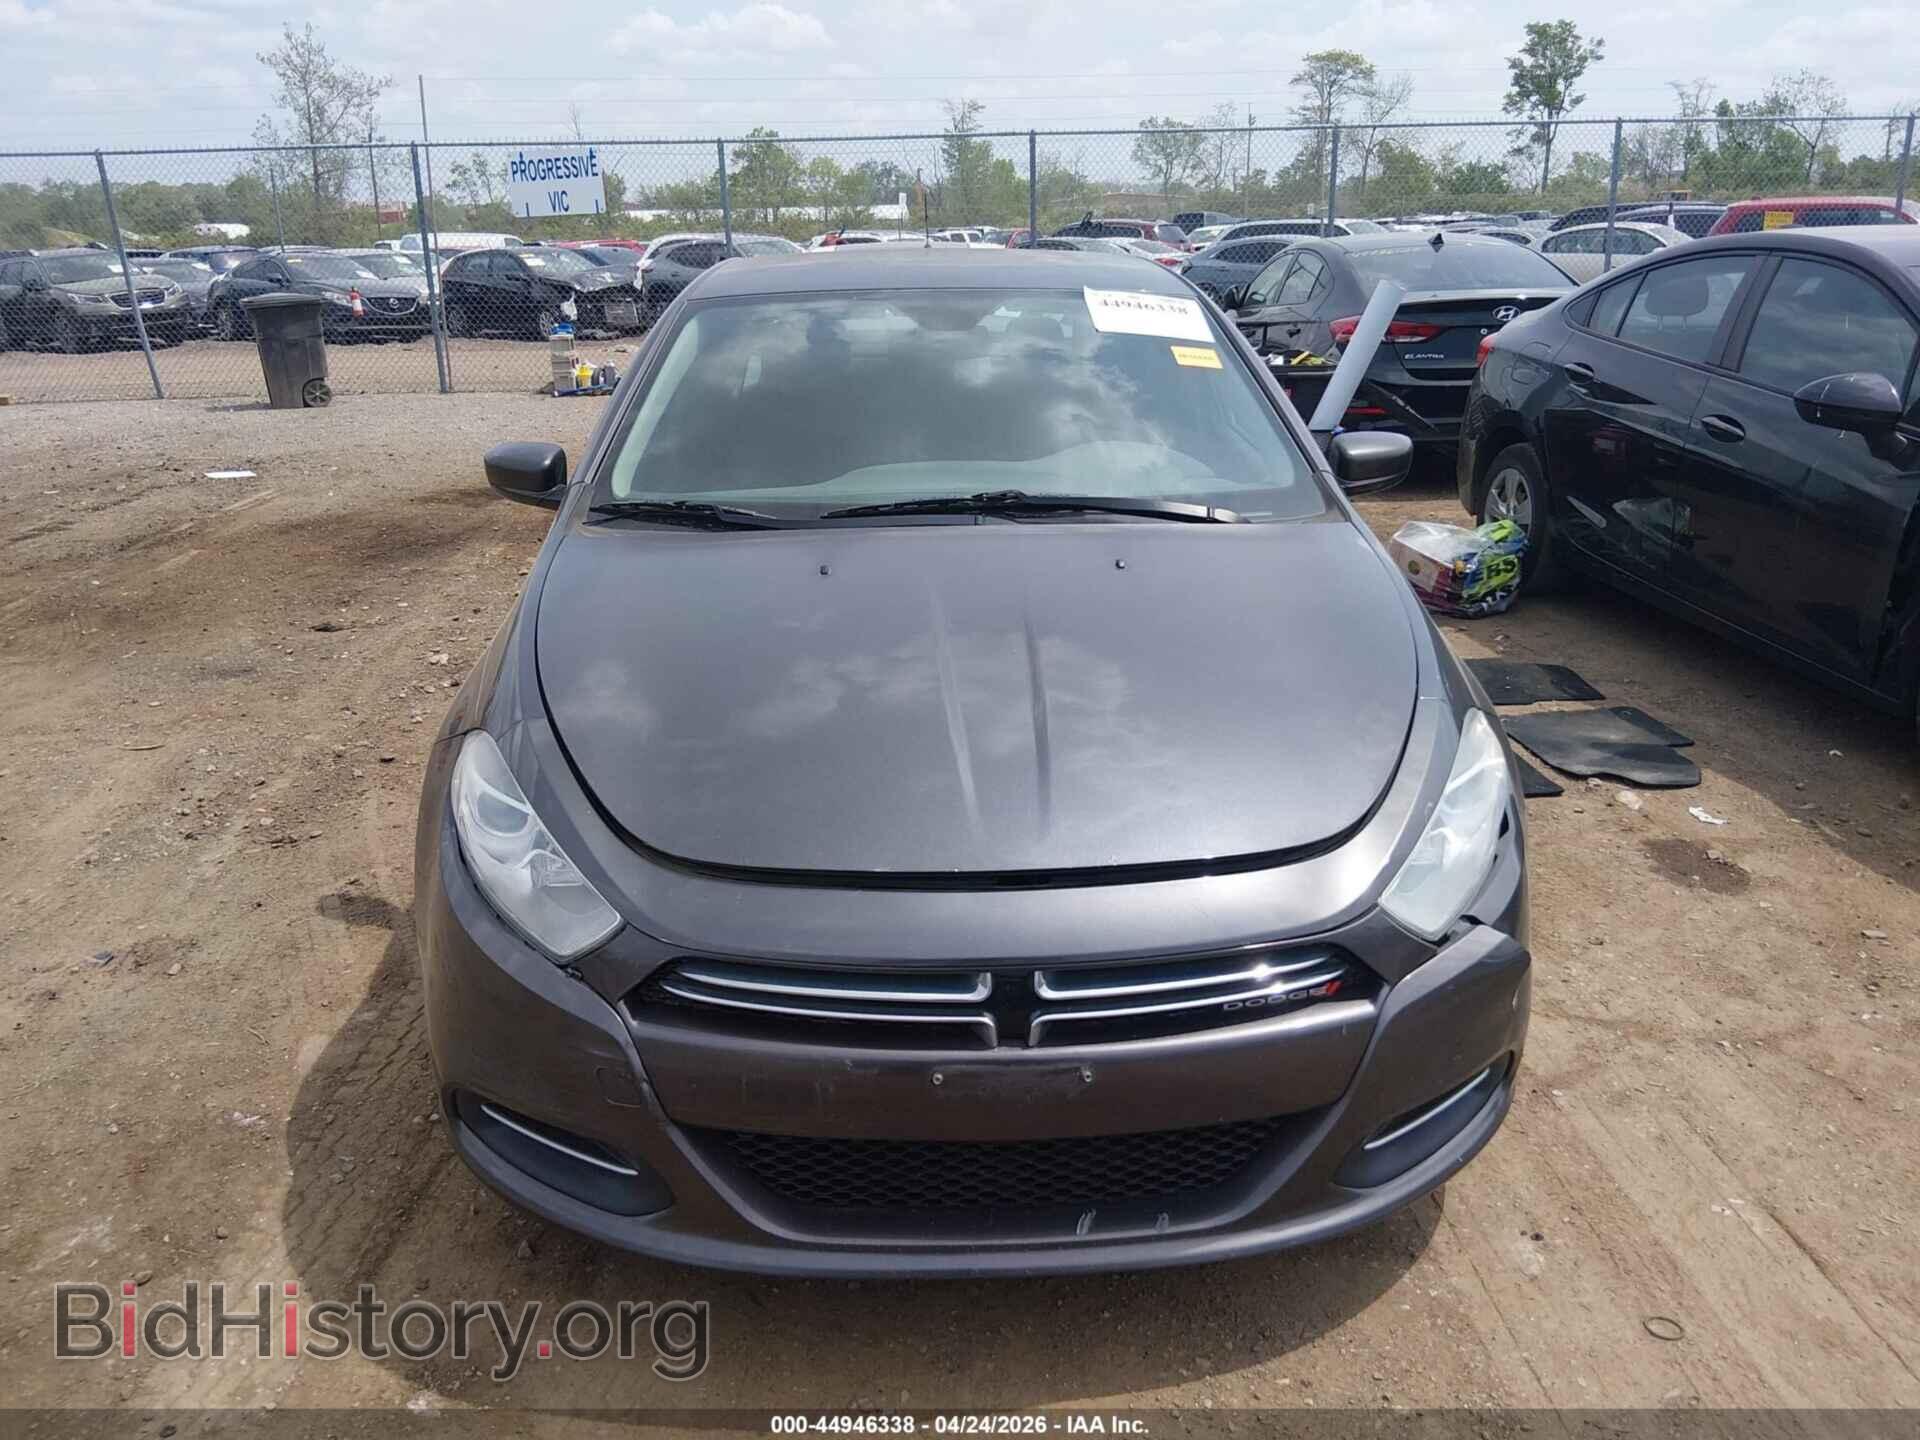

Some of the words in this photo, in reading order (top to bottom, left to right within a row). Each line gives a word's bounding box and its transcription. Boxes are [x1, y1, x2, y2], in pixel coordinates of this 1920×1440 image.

[511, 155, 598, 182] PROGRESSIVE
[548, 190, 569, 212] VIC
[1223, 987, 1329, 1011] DODGE
